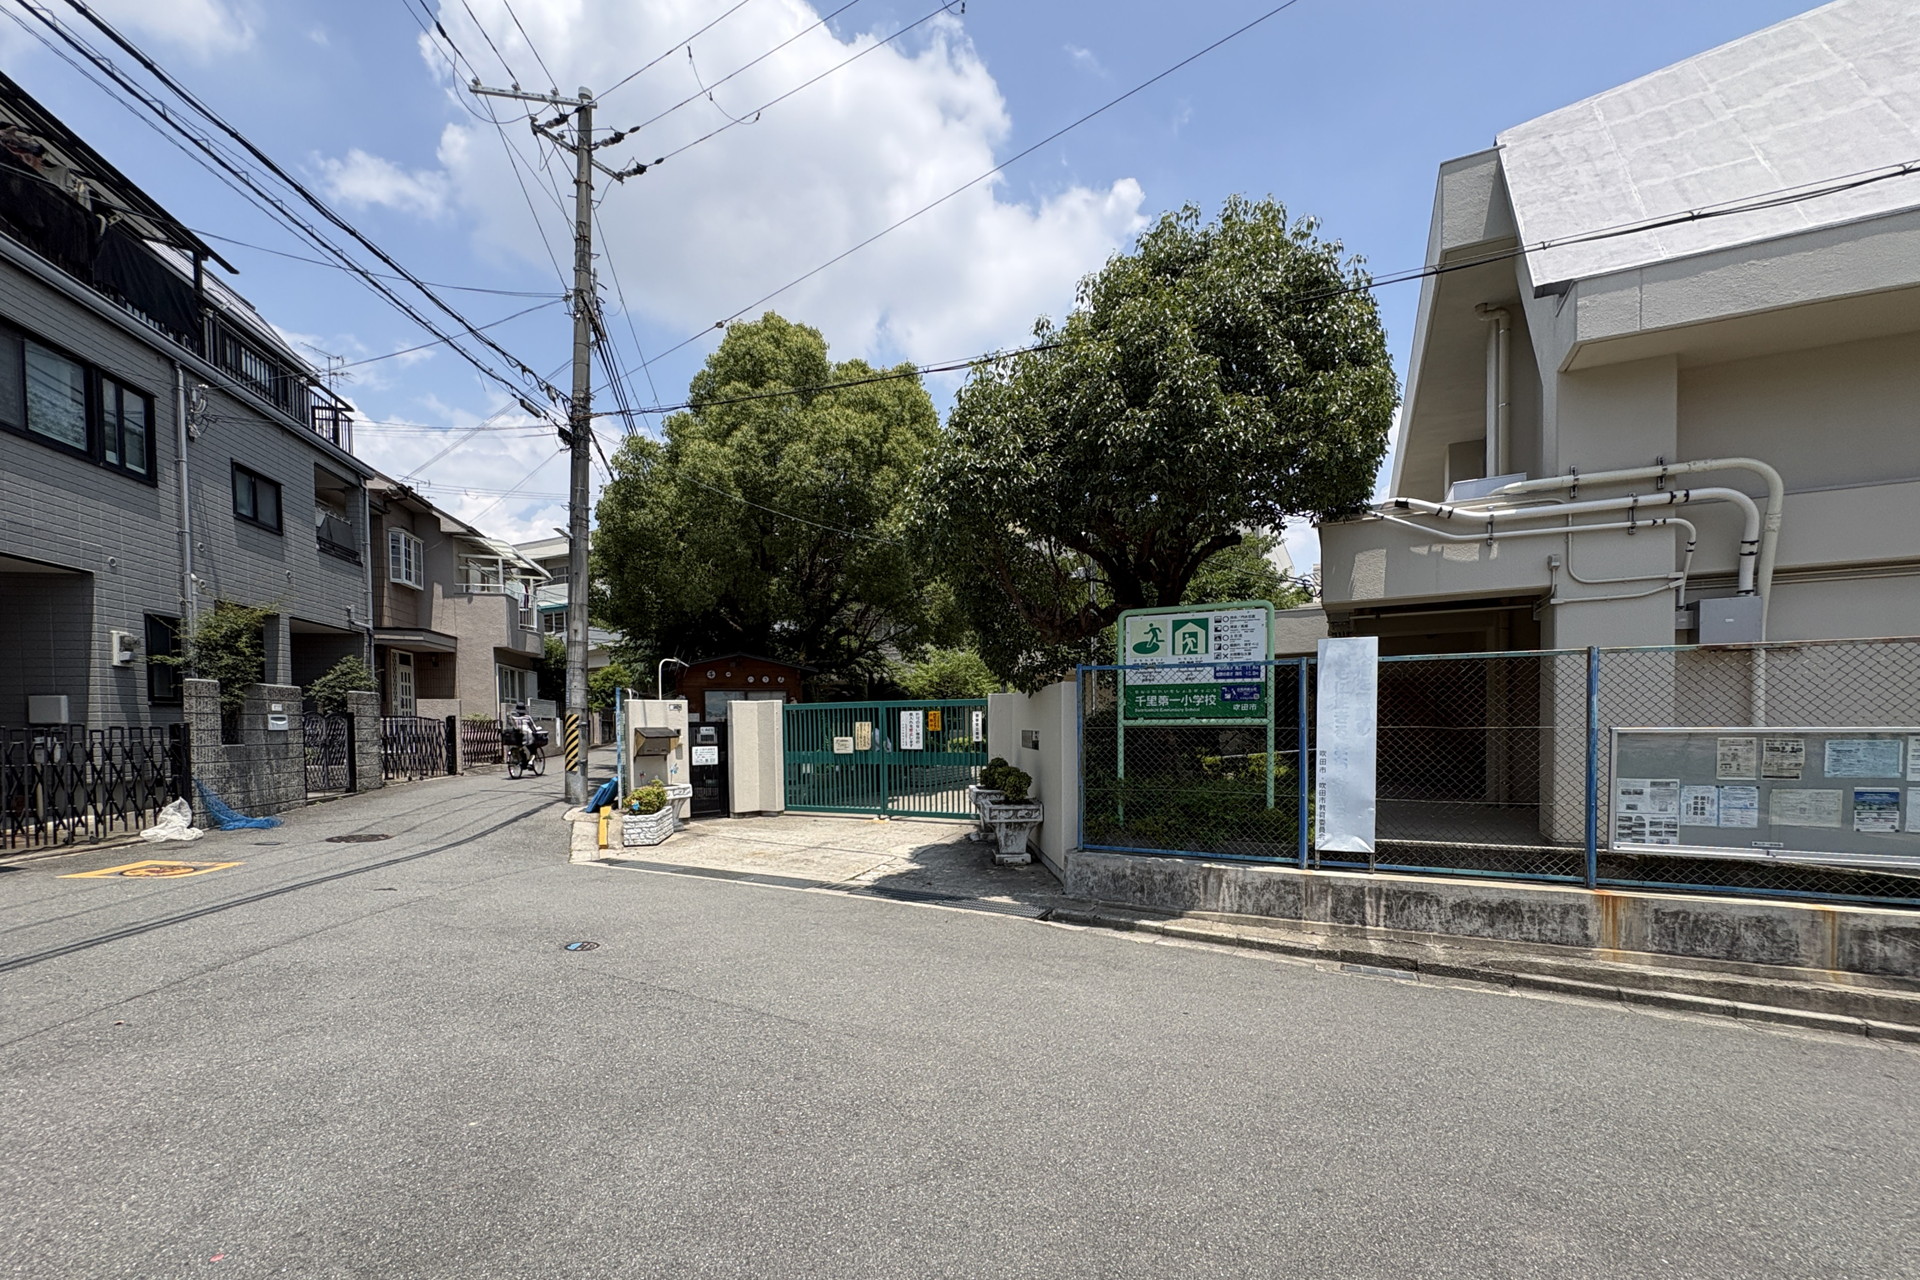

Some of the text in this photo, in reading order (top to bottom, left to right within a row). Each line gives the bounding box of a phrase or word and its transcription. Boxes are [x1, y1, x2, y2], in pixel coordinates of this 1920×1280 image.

[1135, 694, 1217, 706] 千里第一小学校
[1232, 703, 1257, 711] 吹田市
[1318, 750, 1327, 841] 吹田市・吹田市教育委員会
